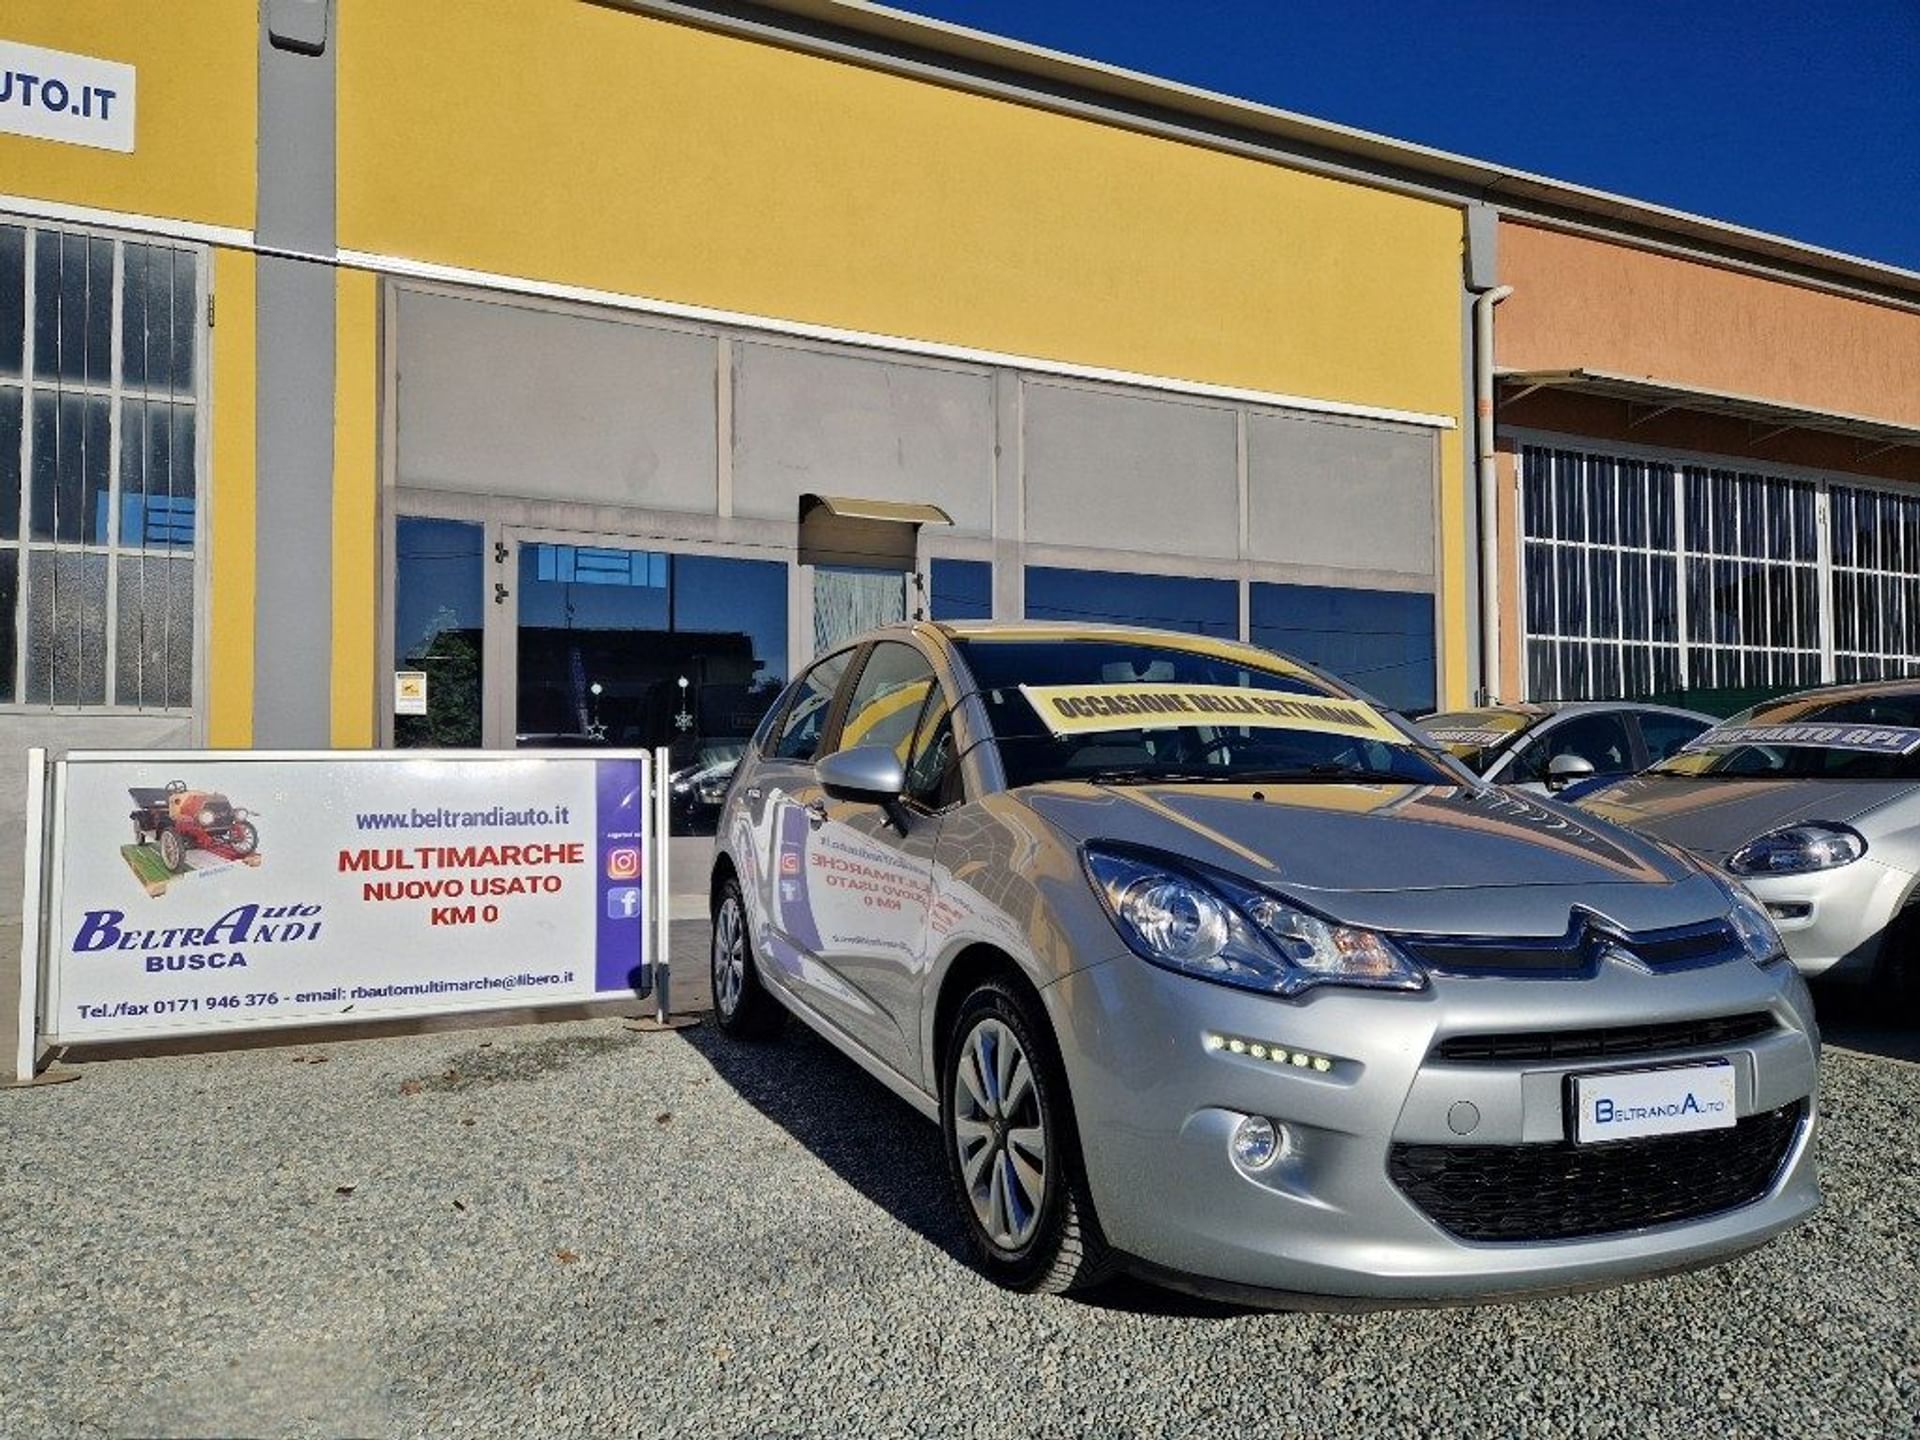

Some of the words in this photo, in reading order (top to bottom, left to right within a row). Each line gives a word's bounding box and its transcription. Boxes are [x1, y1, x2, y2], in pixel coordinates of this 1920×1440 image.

[1051, 694, 1196, 718] OCCASIONE
[1185, 694, 1263, 714] DELLA
[356, 806, 570, 830] www.beltrandiauto.it
[337, 843, 585, 872] MULTIMARCHE
[363, 879, 464, 901] NUOVO
[470, 875, 562, 897] USATO
[431, 906, 476, 926] KM
[482, 905, 499, 923] 0
[146, 952, 248, 973] BUSCA
[77, 1000, 149, 1020] Tel./fax
[154, 998, 200, 1014] 0171
[206, 995, 241, 1010] 946
[245, 992, 280, 1007] 376
[295, 986, 347, 1003] email:
[351, 971, 574, 999] rbautomultimarche@libero.it
